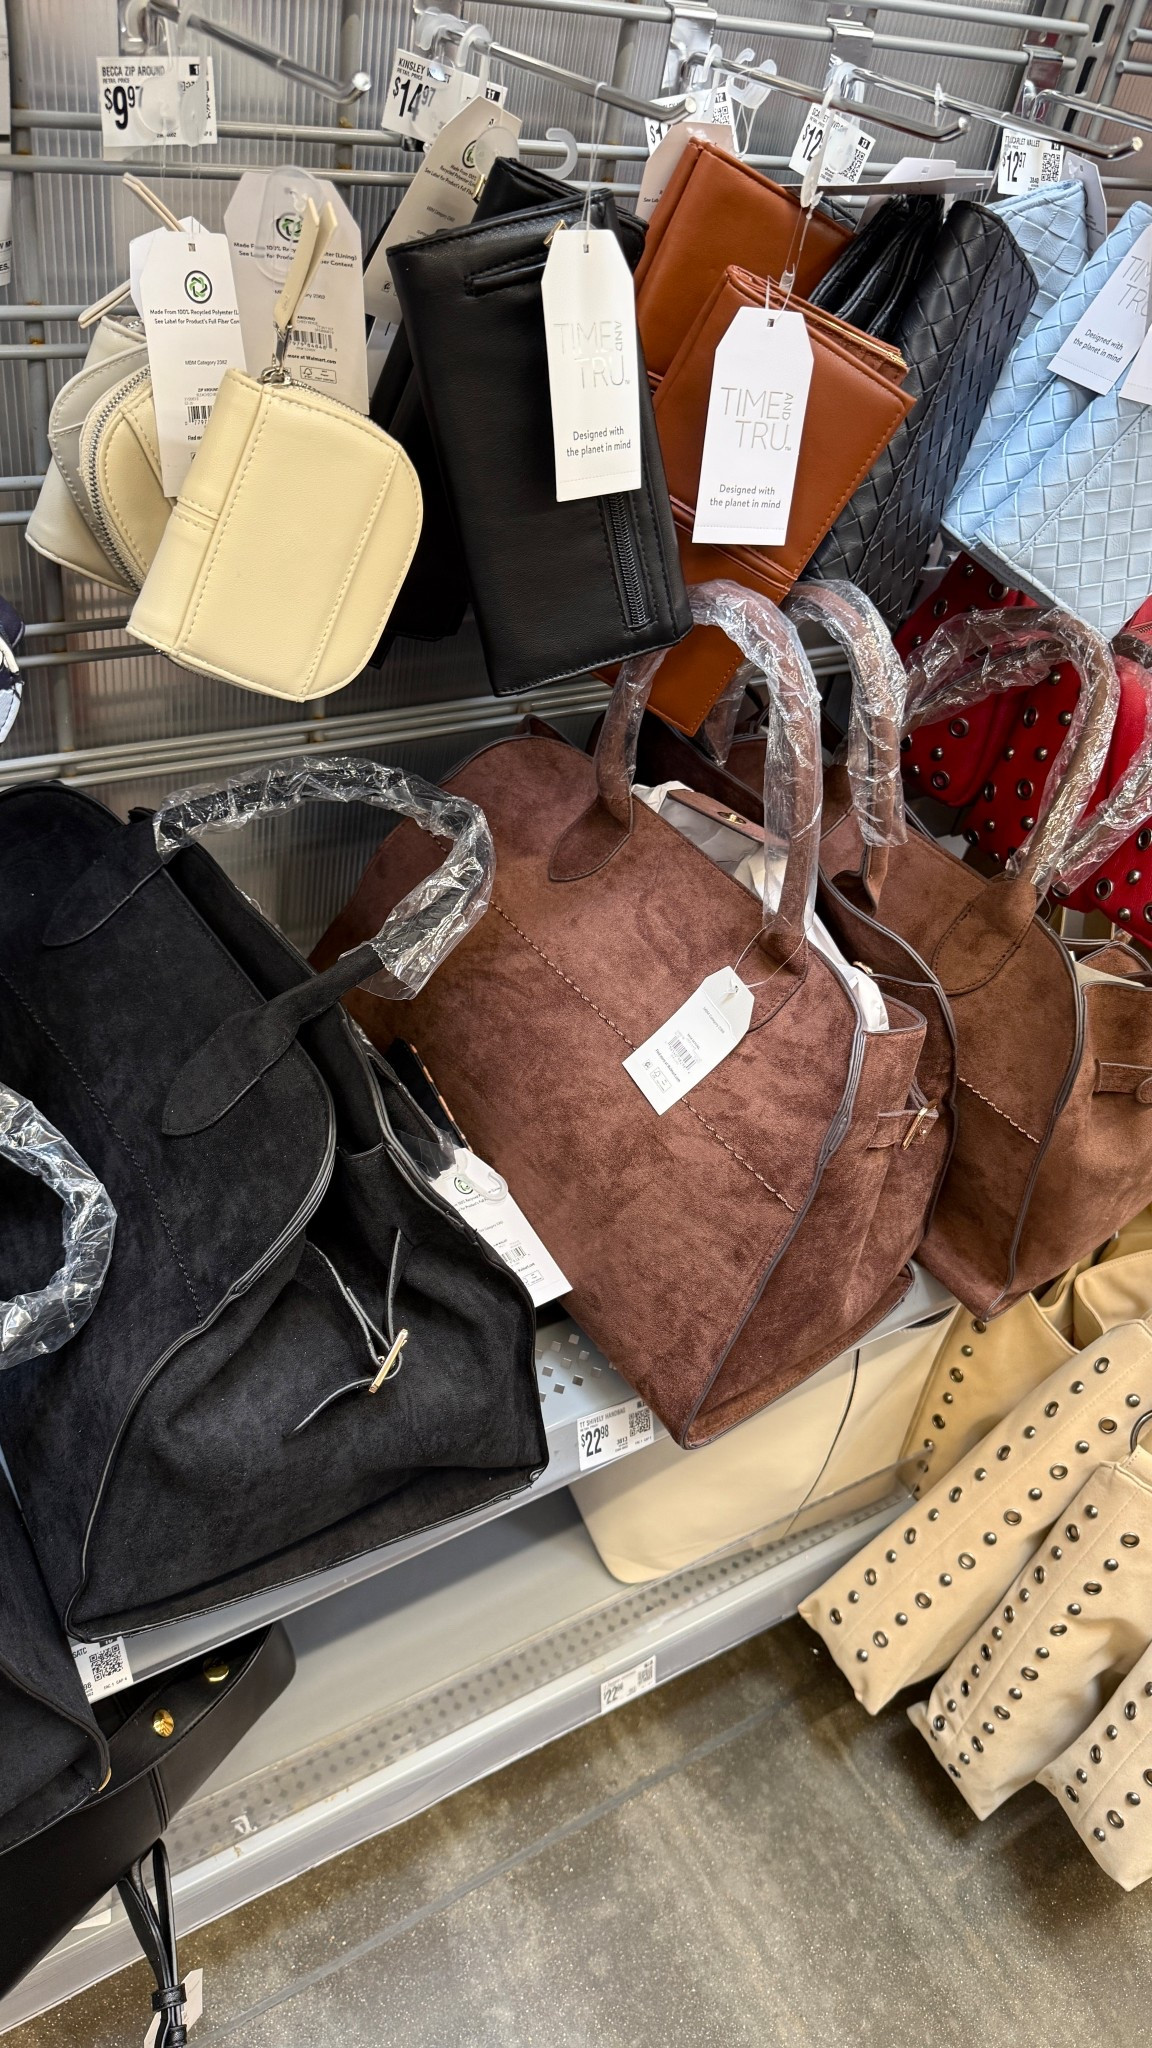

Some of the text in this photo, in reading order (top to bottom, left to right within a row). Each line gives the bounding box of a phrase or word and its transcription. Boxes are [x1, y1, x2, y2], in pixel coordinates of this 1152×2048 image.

[102, 65, 166, 77] BECCA ZIP AROUND
[398, 57, 425, 75] KINSLEY
[1026, 139, 1041, 148] WALLET
[430, 171, 440, 179] Label
[439, 165, 455, 178] Recycled
[459, 168, 469, 176] From
[330, 260, 354, 268] Content
[190, 309, 211, 317] Recycled
[211, 309, 233, 317] Polyester
[553, 320, 612, 355] TIME
[1084, 328, 1125, 351] Designed with
[1073, 337, 1123, 364] the planet in mind
[306, 355, 337, 365] Walmart.com
[720, 386, 784, 420] TIME
[782, 392, 794, 422] AND
[572, 425, 625, 442] Designed with
[735, 420, 789, 451] TRU
[566, 439, 632, 458] the planet in mind
[719, 484, 776, 496] Designed with
[709, 497, 781, 509] the planet in mind
[586, 1415, 605, 1426] SHIVELY
[604, 1407, 626, 1419] HANDBAG
